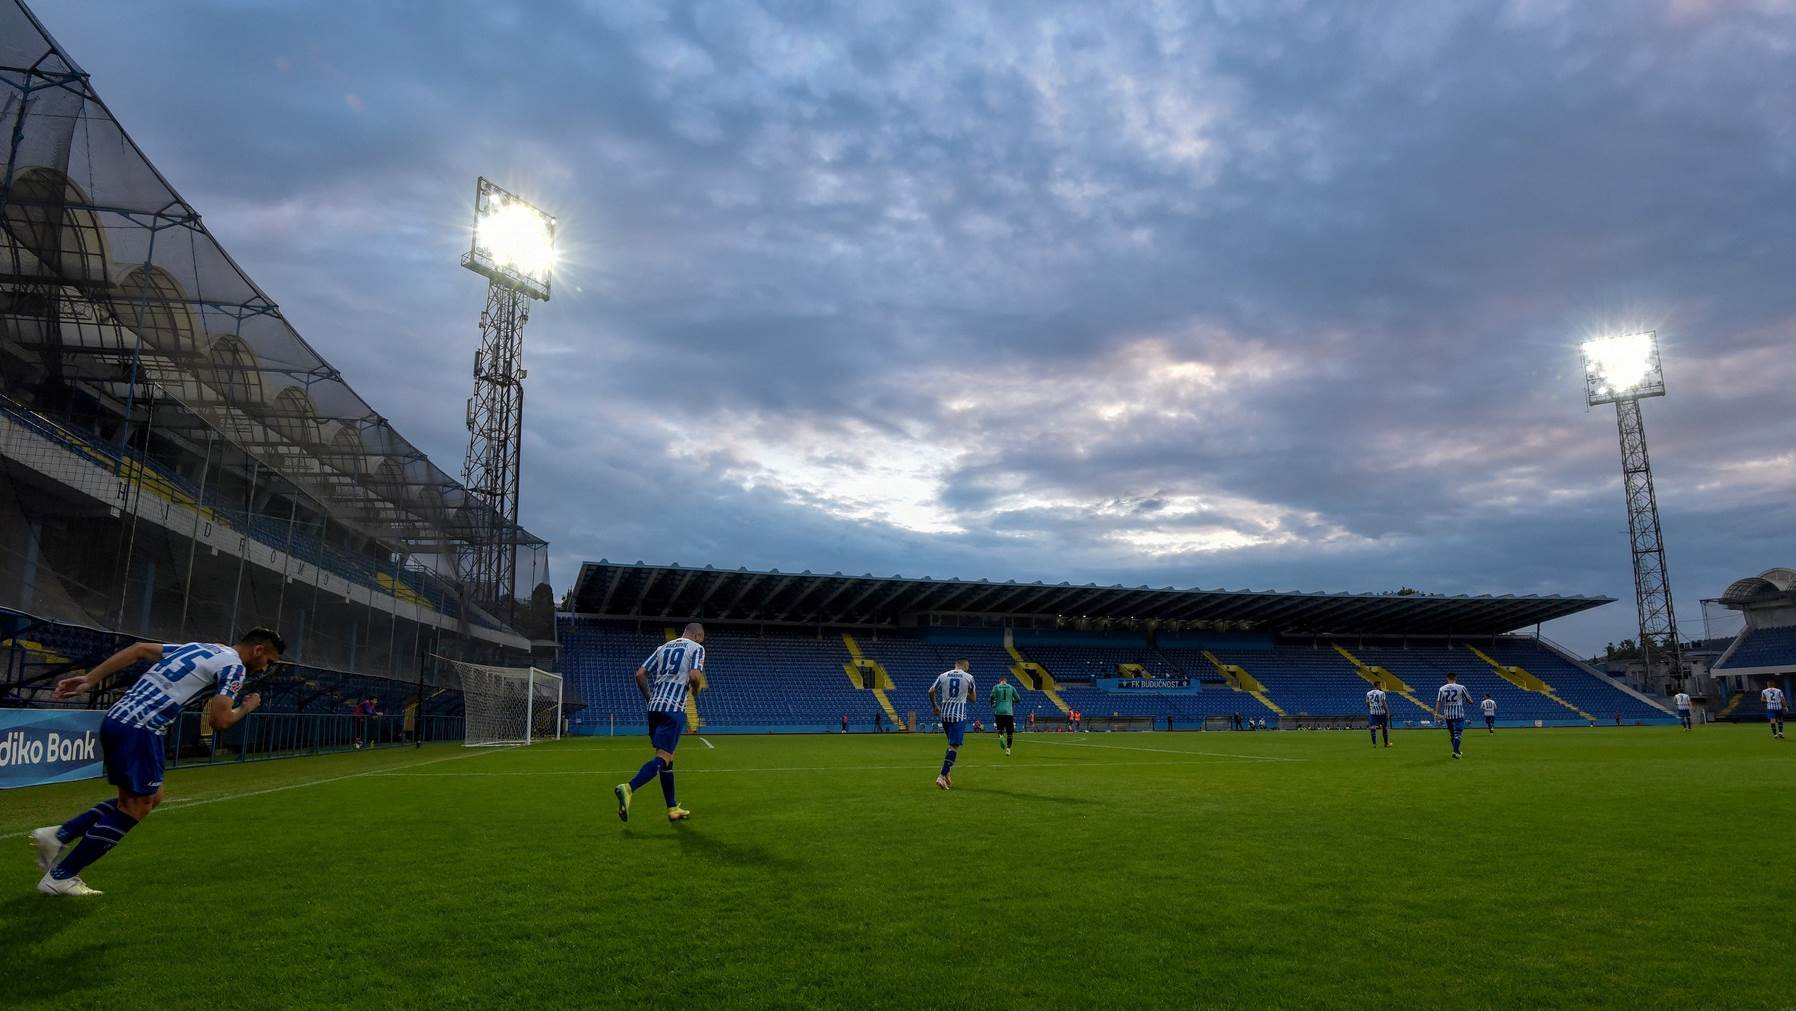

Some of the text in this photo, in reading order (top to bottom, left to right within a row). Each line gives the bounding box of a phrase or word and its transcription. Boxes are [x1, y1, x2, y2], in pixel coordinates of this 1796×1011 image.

[660, 648, 685, 674] 19
[949, 678, 960, 697] 8
[1444, 690, 1458, 702] 22
[47, 731, 95, 763] Bank
